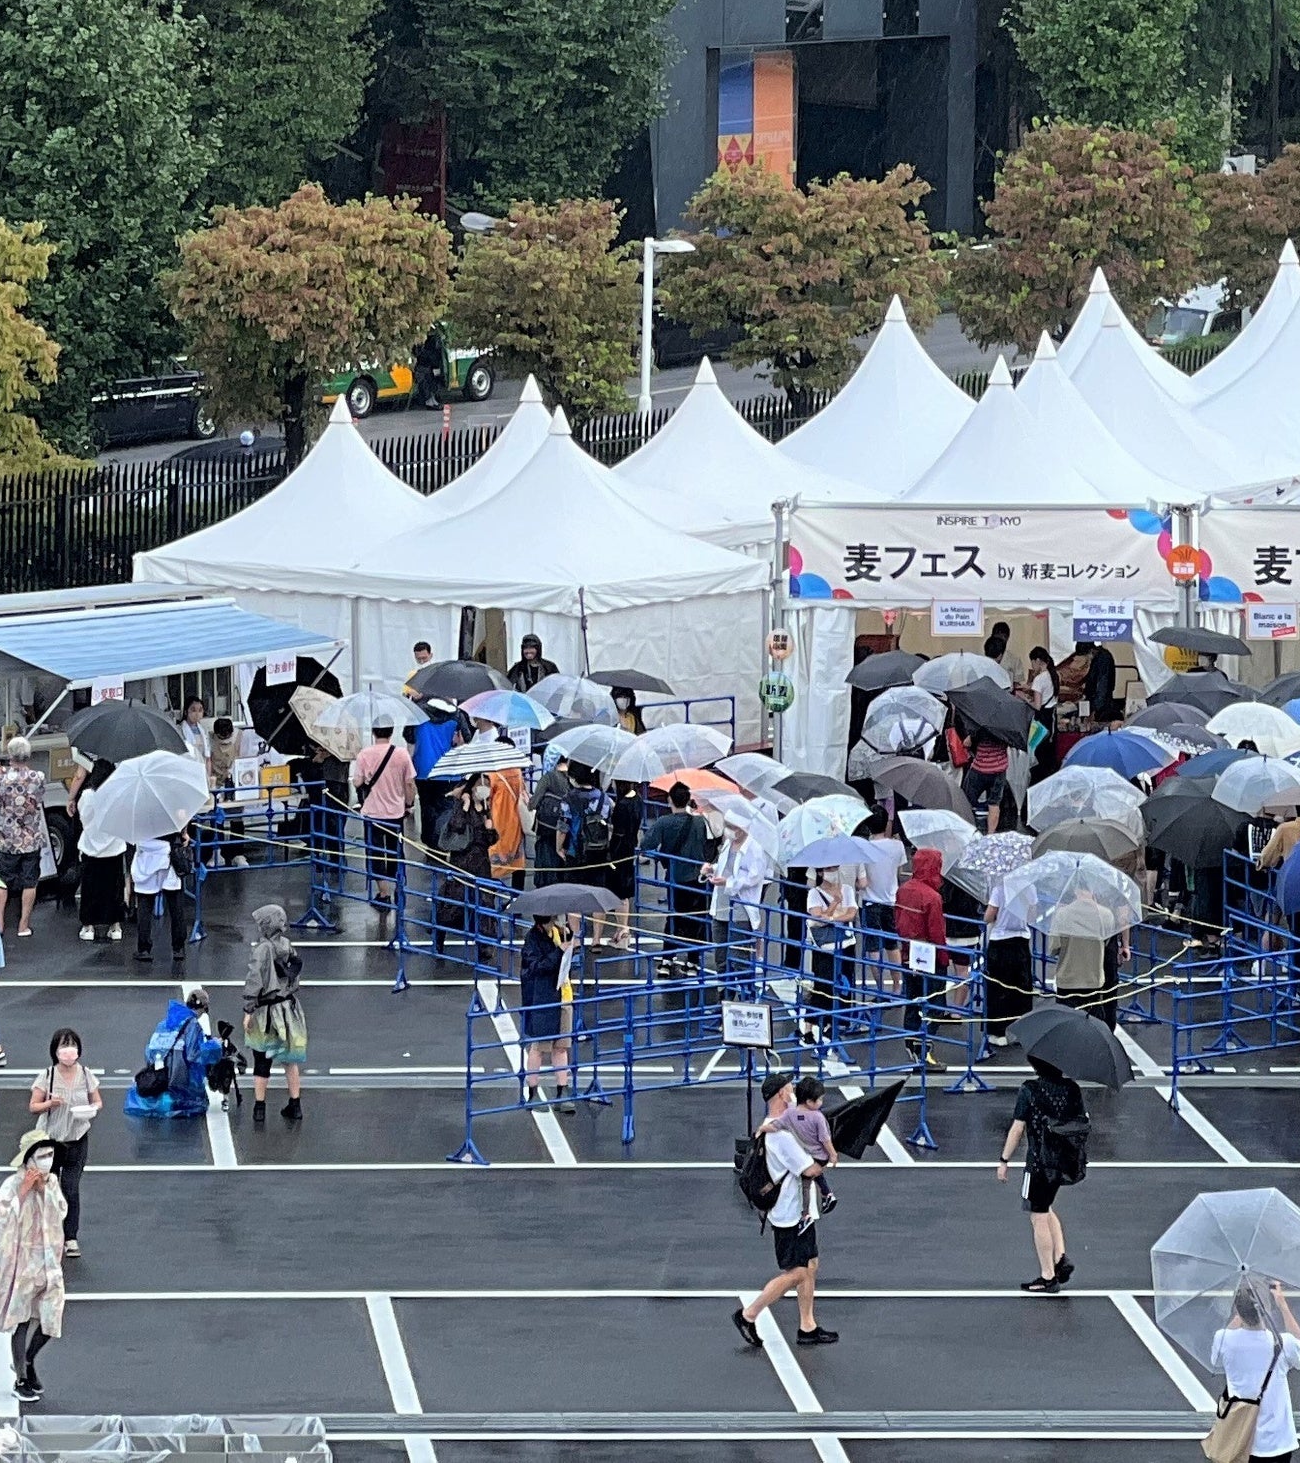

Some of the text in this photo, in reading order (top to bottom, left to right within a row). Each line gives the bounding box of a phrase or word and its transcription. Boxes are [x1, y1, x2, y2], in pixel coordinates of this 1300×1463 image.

[937, 516, 977, 526] INSPIRE
[844, 543, 1140, 582] 麦フェス by 新麦コレクション
[1253, 612, 1274, 620] Blanc
